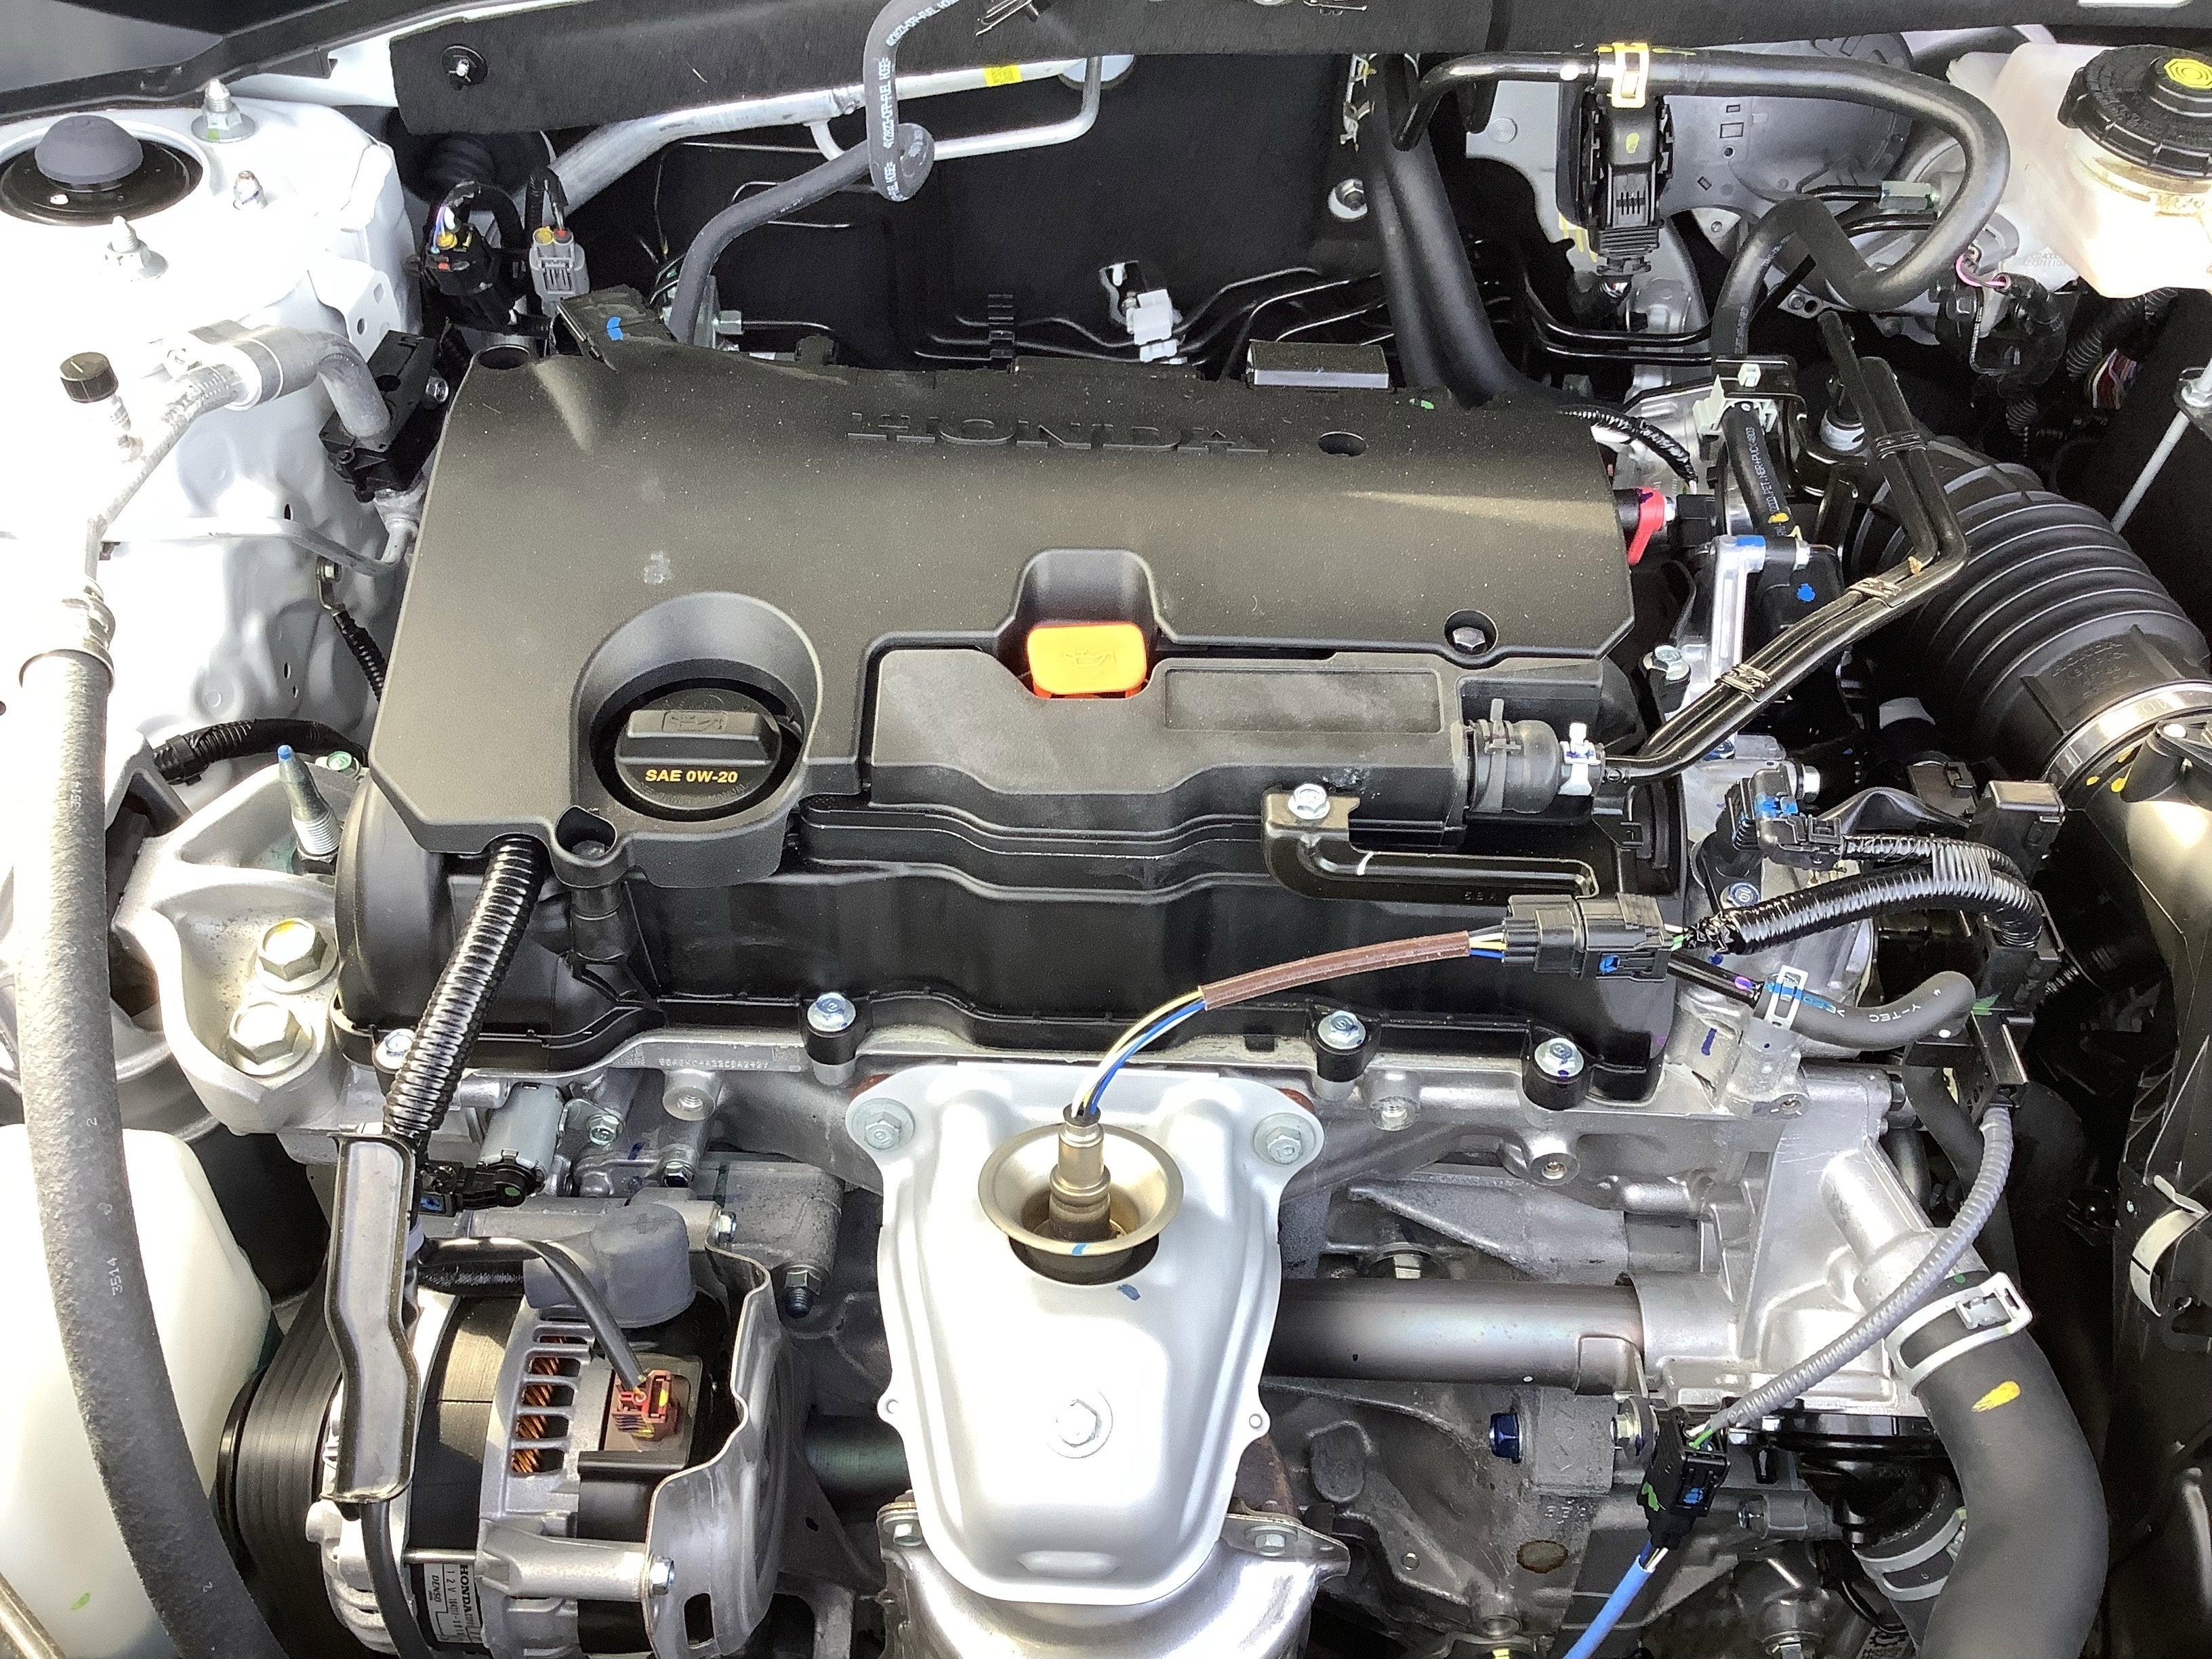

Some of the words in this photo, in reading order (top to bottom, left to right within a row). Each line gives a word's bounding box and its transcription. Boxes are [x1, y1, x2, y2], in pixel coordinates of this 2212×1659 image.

[848, 412, 1269, 453] HONDA
[645, 769, 683, 782] SAE
[686, 771, 738, 783] 0W-20
[708, 780, 752, 804] MANUAL
[1868, 1003, 1922, 1023] Y-TEC
[106, 1257, 123, 1296] 3514
[432, 1574, 441, 1603] DENSO
[460, 1564, 472, 1612] HONDA
